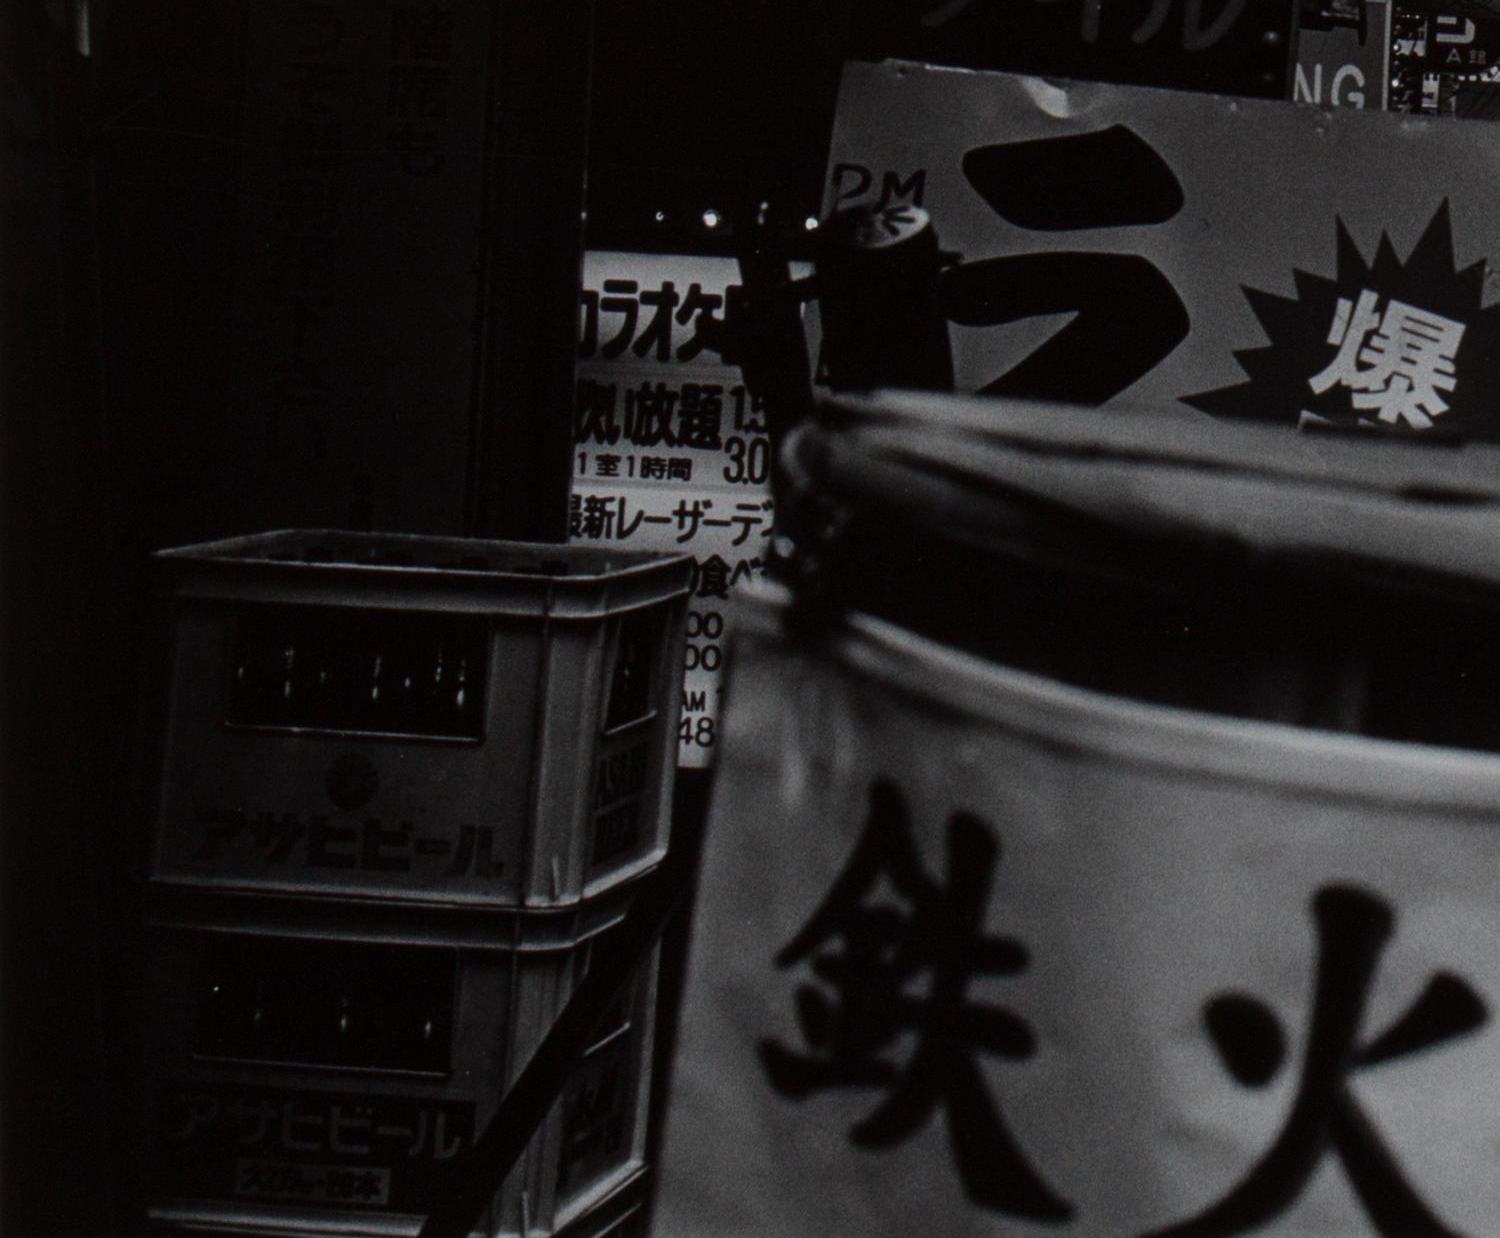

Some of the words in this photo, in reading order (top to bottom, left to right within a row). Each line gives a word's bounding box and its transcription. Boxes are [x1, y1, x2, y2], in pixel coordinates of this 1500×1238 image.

[1307, 288, 1467, 432] 爆
[576, 451, 693, 482] 1室1時間
[205, 813, 507, 881] アサヒビール
[172, 1093, 468, 1162] アサヒビール
